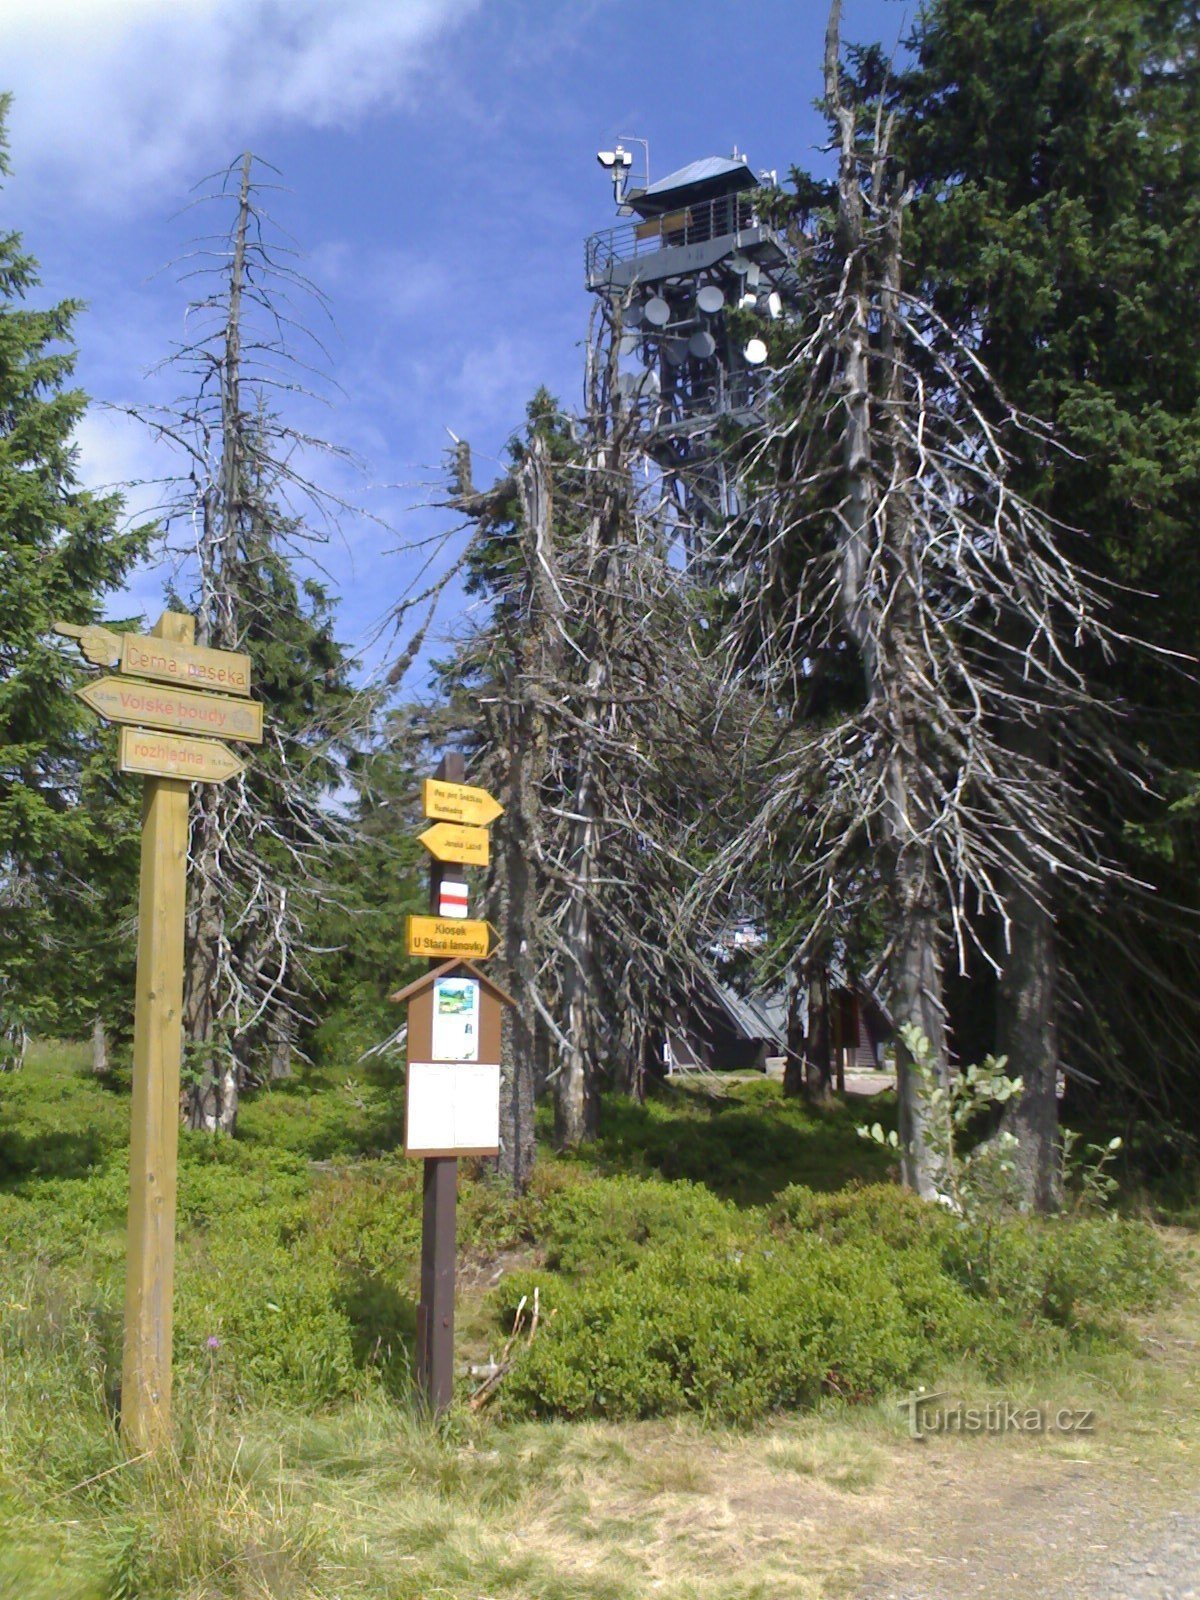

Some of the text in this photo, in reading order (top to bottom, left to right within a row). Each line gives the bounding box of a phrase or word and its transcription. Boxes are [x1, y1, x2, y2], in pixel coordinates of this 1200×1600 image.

[187, 662, 245, 685] paseka
[119, 691, 227, 726] Volské boudy
[134, 744, 204, 765] rozhledna
[413, 936, 421, 948] U
